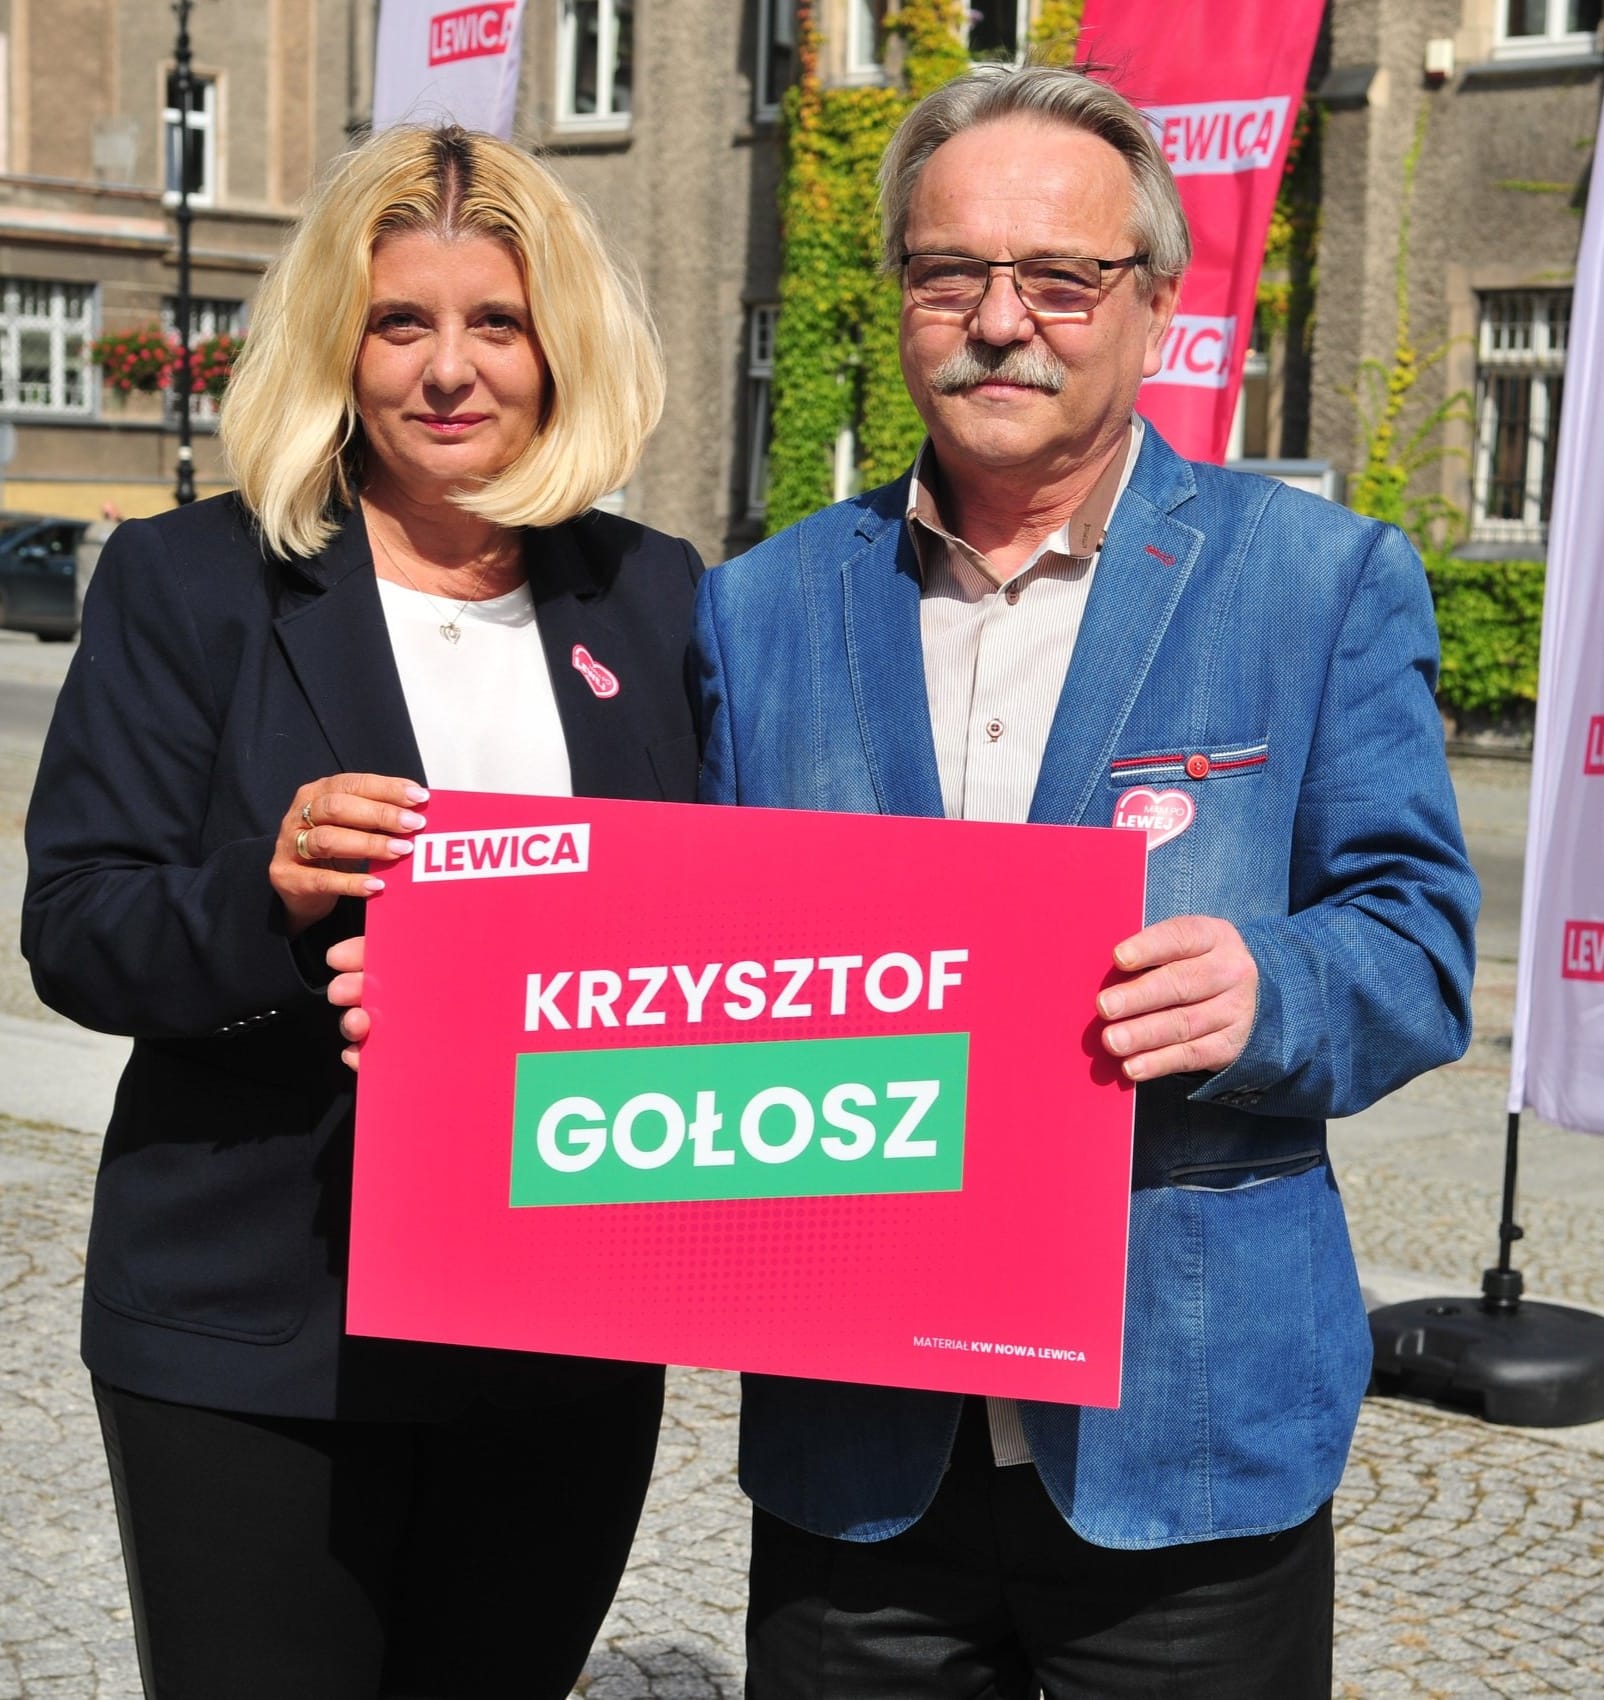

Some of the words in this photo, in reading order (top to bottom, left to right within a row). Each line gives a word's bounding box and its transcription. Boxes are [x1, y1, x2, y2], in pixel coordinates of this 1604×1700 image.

[431, 9, 515, 57] LEWICA
[1161, 109, 1275, 162] EWICA
[1116, 811, 1174, 830] LEWEJ
[424, 832, 579, 873] LEWICA
[524, 949, 969, 1031] KRZYSZTOF
[536, 1080, 940, 1172] GOŁOSZ
[913, 1336, 968, 1351] MATERIAŁ
[971, 1341, 993, 1354] KW
[995, 1344, 1035, 1357] NOWA
[1038, 1347, 1086, 1362] LEWICA
